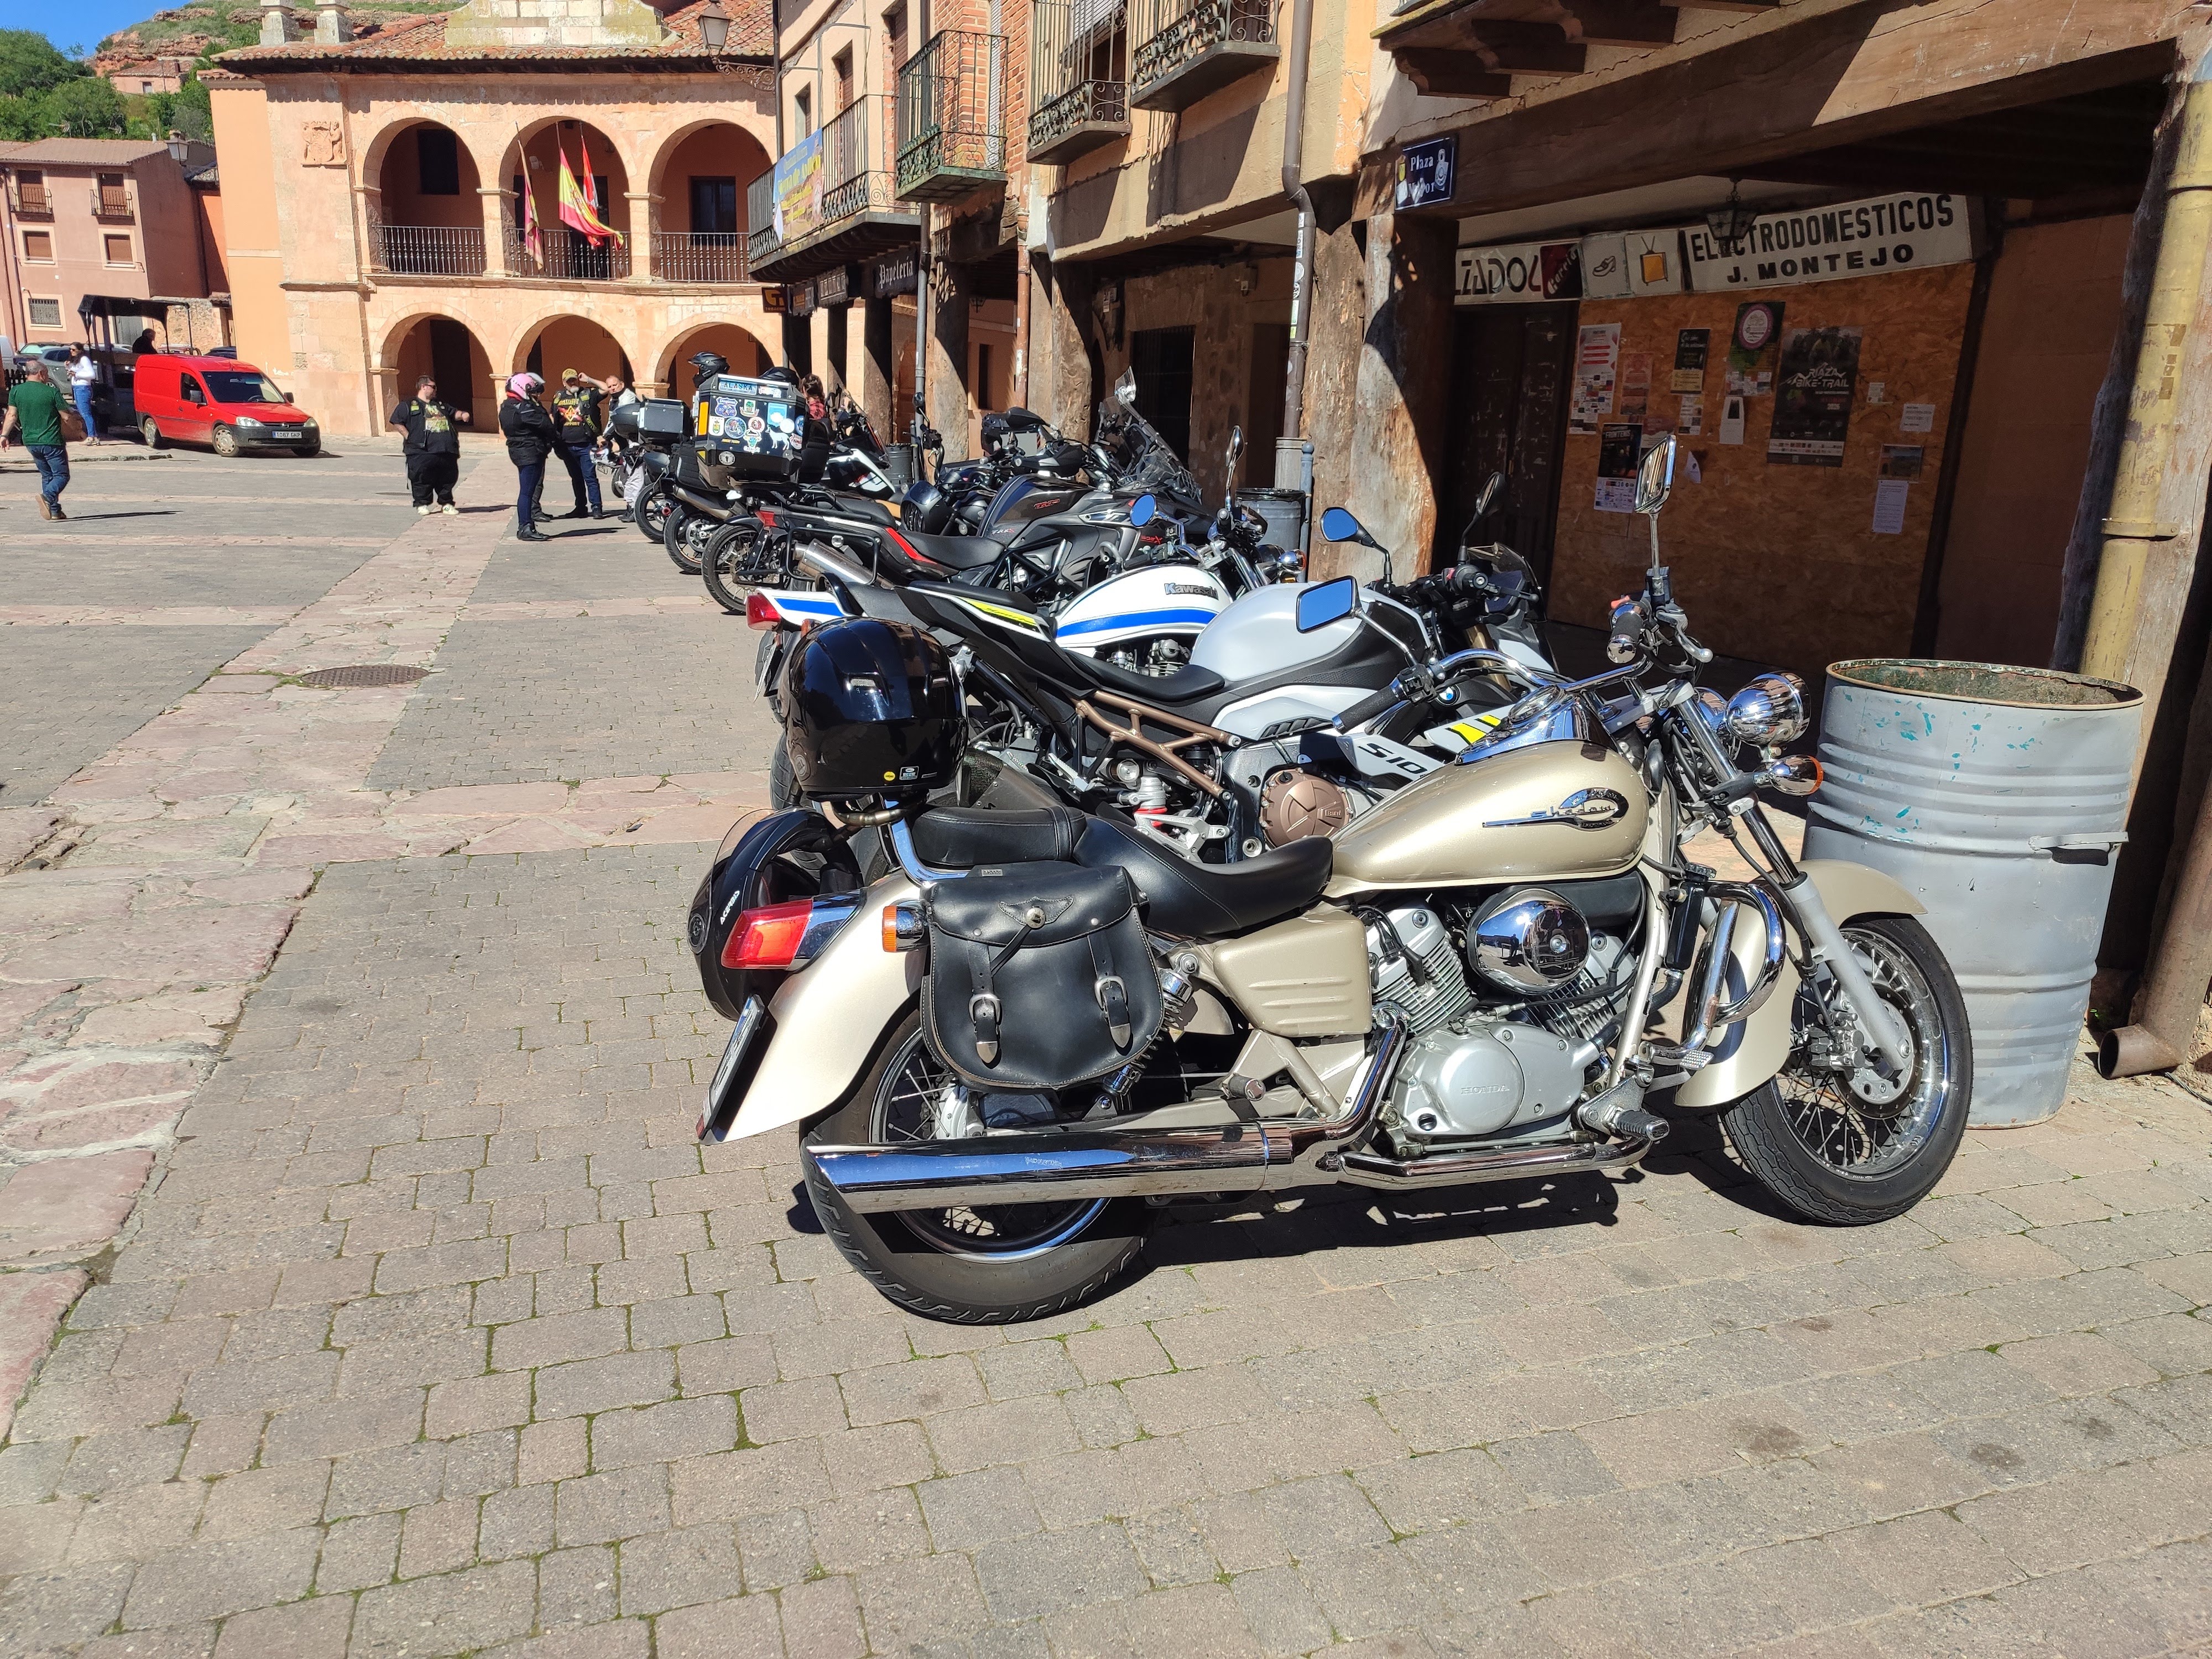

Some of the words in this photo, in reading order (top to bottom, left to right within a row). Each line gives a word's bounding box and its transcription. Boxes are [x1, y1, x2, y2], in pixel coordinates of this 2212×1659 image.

[1411, 155, 1434, 171] Plaza
[1408, 181, 1435, 197] Mor
[879, 255, 913, 289] Papelería
[1727, 267, 1747, 284] J.
[1759, 244, 1914, 280] MONTEJO
[1809, 368, 1838, 378] RIAZA
[723, 382, 753, 390] ALASKA
[1796, 378, 1849, 387] BIKE-TRAIL
[1164, 583, 1219, 601] Kawasaki
[1357, 743, 1428, 778] S10
[1530, 802, 1611, 818] Shadow
[1460, 1084, 1510, 1095] HONDA
